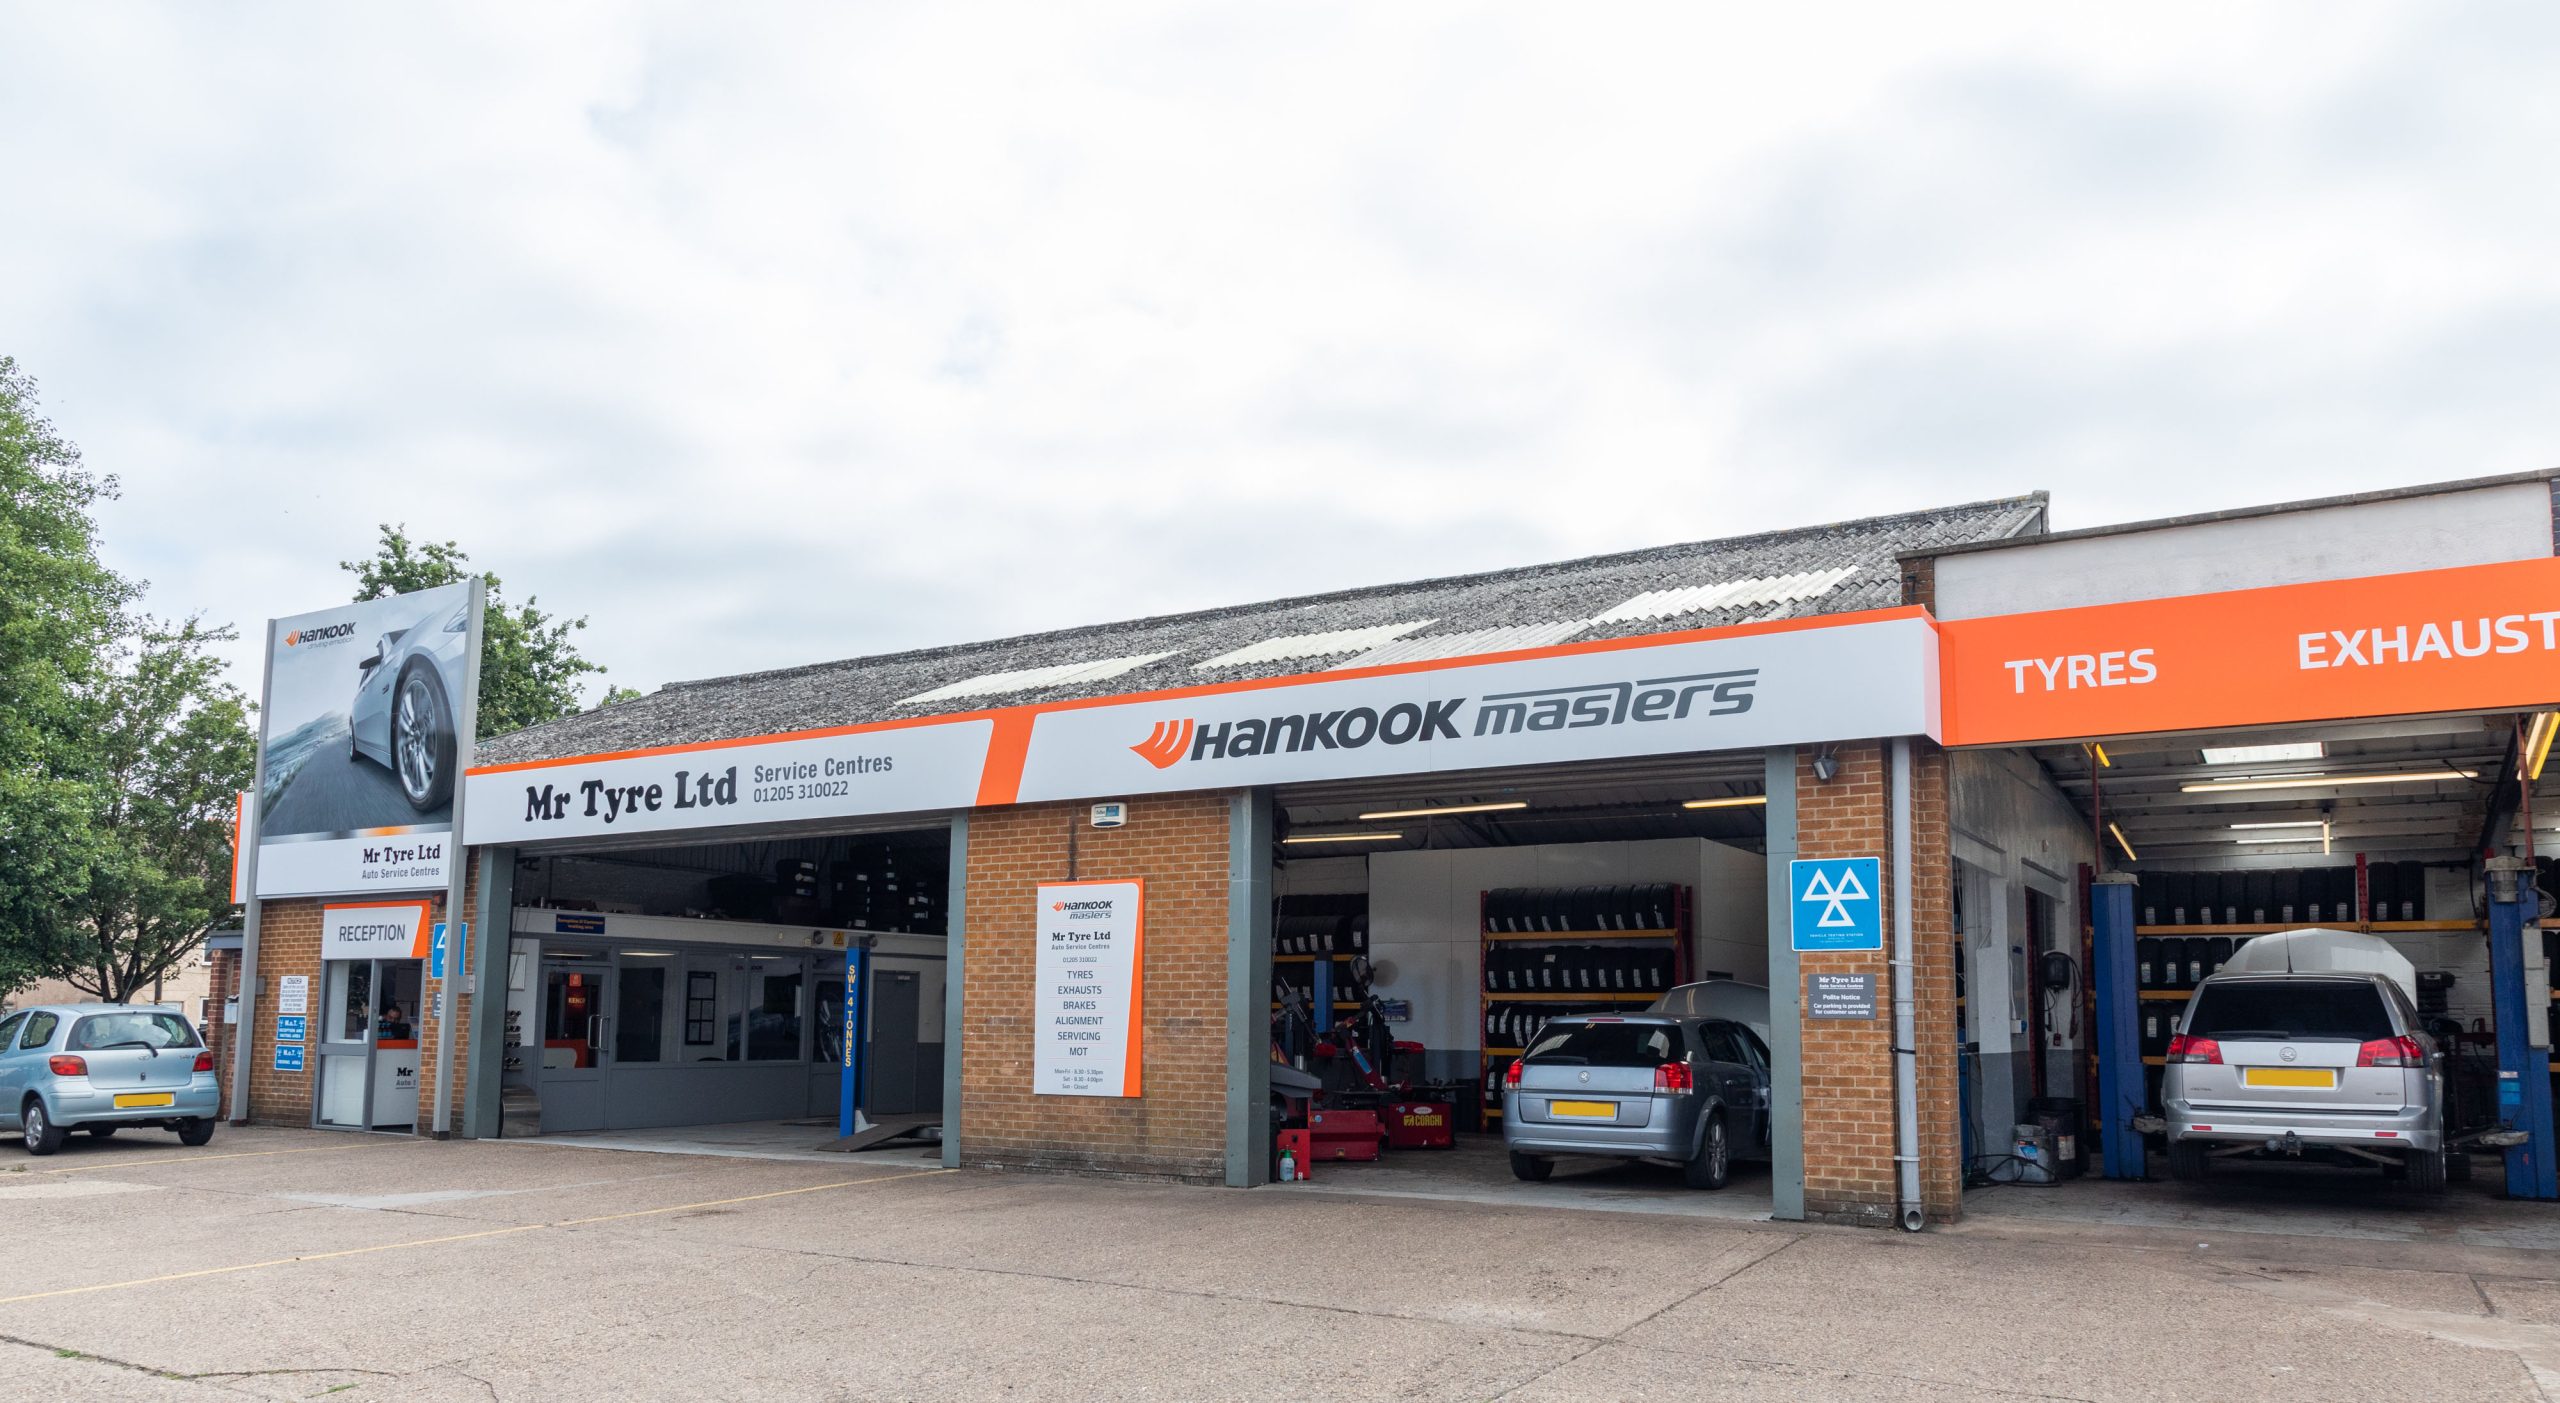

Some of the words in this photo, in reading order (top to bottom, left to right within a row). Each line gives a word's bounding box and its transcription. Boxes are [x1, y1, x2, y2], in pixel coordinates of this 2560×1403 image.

[2004, 648, 2158, 694] TYRES
[1474, 668, 1760, 737] masters
[754, 761, 818, 783] Service
[824, 755, 893, 777] Centres
[525, 784, 571, 822] Mr
[580, 779, 663, 824] Tyre
[674, 766, 738, 809] Ltd
[753, 785, 794, 803] 01205
[798, 780, 849, 799] 310022
[363, 848, 380, 864] Mr
[383, 846, 415, 865] Tyre
[418, 844, 441, 860] Ltd
[362, 869, 379, 879] Auto
[381, 868, 409, 878] Service
[410, 866, 440, 877] Centres
[339, 924, 405, 942] RECEPTION
[1052, 932, 1066, 941] Mr
[1068, 932, 1091, 942] Tyre
[1094, 931, 1111, 940] Ltd
[847, 965, 856, 993] SWL
[1067, 970, 1094, 979] TYRES
[1058, 985, 1102, 995] EXHAUSTS
[847, 997, 854, 1007] 4
[1063, 1001, 1096, 1010] BRAKES
[1055, 1016, 1104, 1025] ALIGNMENT
[845, 1011, 854, 1067] TONNES
[1058, 1032, 1101, 1041] SERVICING
[1069, 1047, 1088, 1056] MOT
[397, 1067, 413, 1077] Mr
[1415, 1114, 1443, 1127] CORGHI
